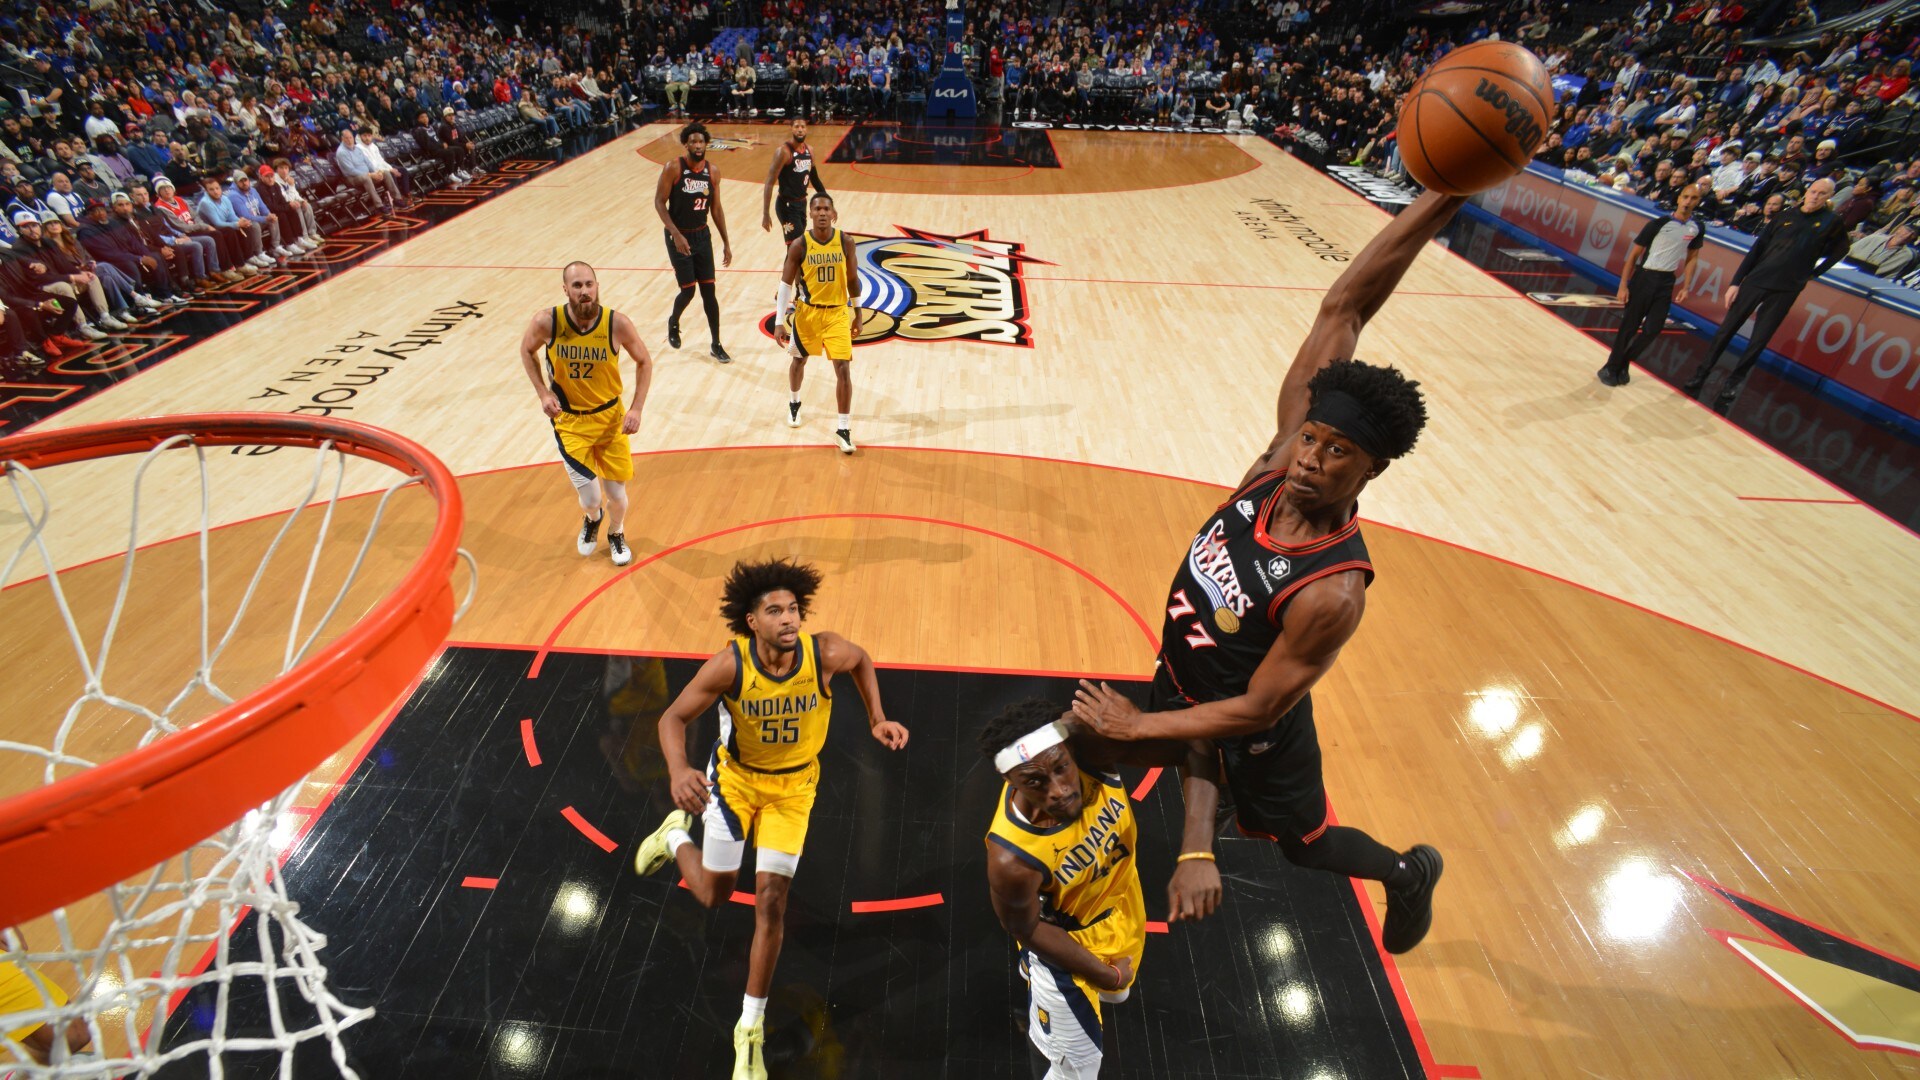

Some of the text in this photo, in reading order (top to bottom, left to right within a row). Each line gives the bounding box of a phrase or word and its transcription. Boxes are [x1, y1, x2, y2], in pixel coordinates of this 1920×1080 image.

[1063, 123, 1256, 136] crypto.com
[1475, 77, 1542, 157] Wilson
[693, 198, 707, 210] 21
[1511, 184, 1579, 238] TOYOTA
[1232, 210, 1279, 240] ARENA
[1250, 198, 1353, 263] xfinity mobile
[807, 252, 843, 266] INDIANA
[817, 265, 836, 283] 00
[373, 300, 488, 360] xfinity
[248, 330, 381, 400] ARENA
[556, 344, 608, 361] INDIANA
[569, 361, 594, 379] 32
[1241, 500, 1255, 517] NIKE
[1193, 519, 1254, 618] SIXERS
[1254, 560, 1273, 594] crypto.com
[1168, 588, 1217, 650] 77
[741, 693, 818, 717] INDIANA
[761, 717, 800, 744] 55
[1053, 797, 1125, 886] INDIANA
